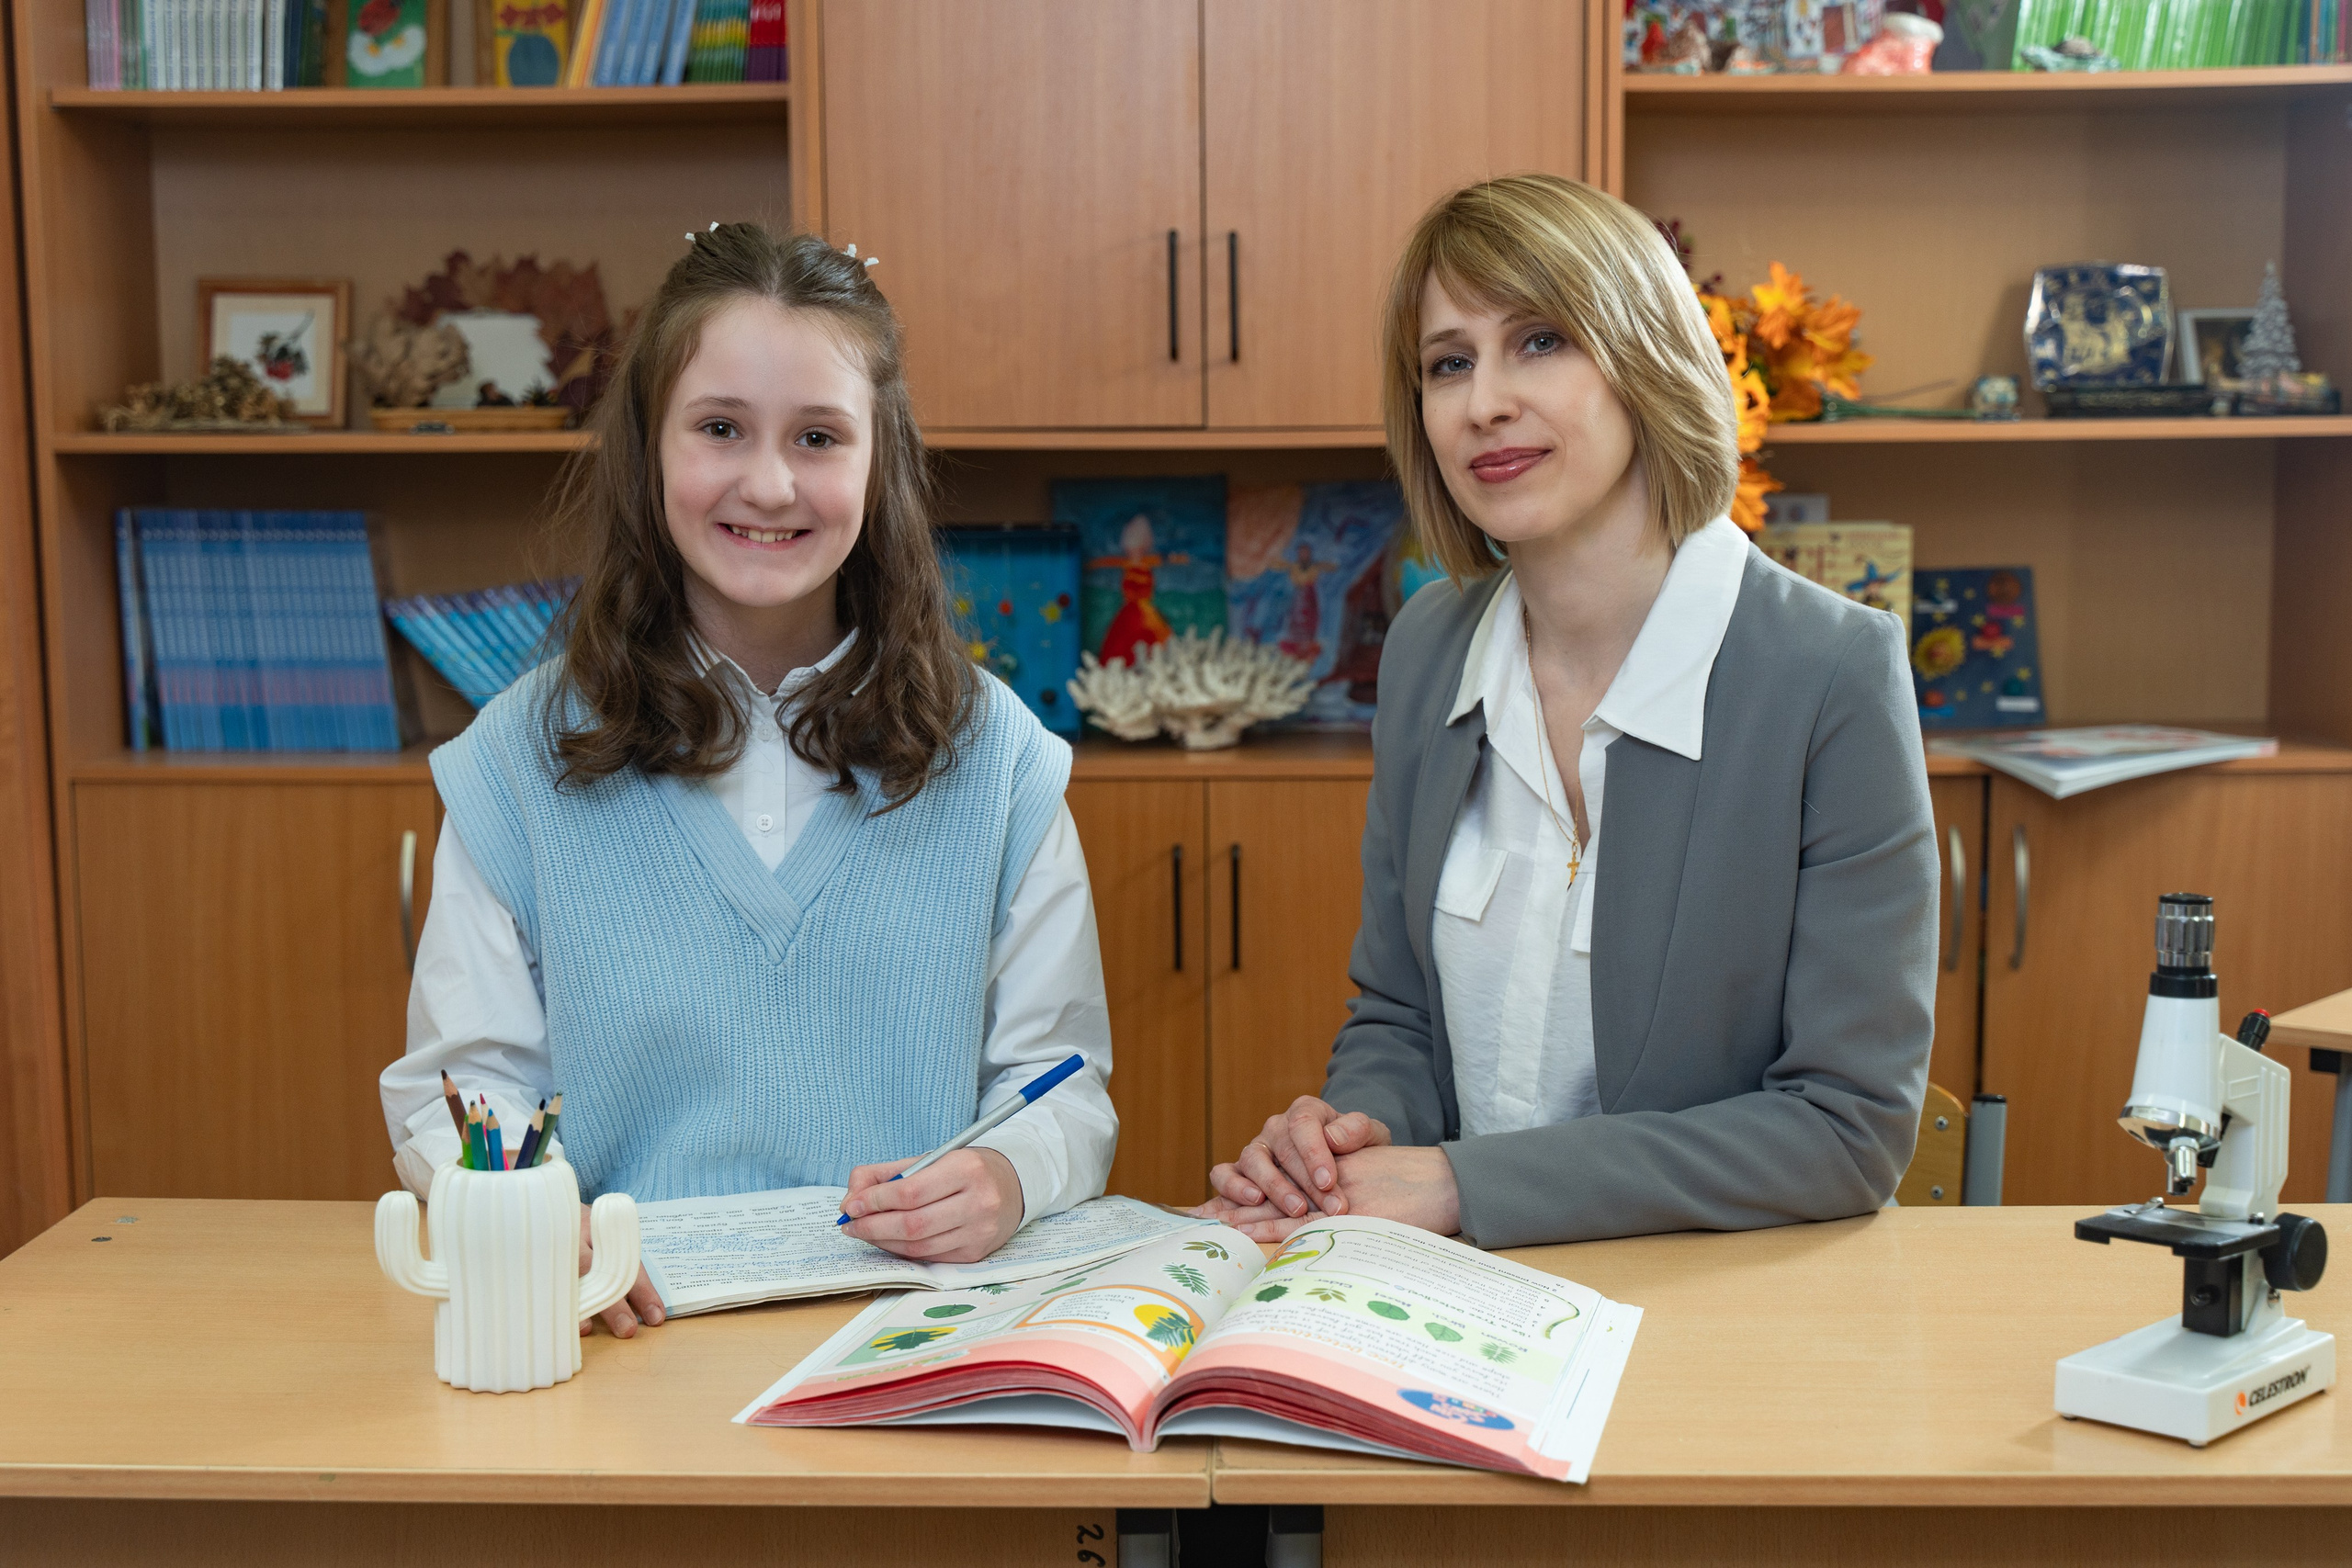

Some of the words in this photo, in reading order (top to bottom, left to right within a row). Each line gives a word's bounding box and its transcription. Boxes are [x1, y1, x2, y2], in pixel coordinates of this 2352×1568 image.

[1386, 1231, 1409, 1239] class.
[1383, 1241, 1406, 1250] Draw
[1352, 1247, 1367, 1256] the
[1385, 1249, 1401, 1258] tree
[1408, 1247, 1430, 1258] tree?
[1438, 1247, 1476, 1262] drawings
[1349, 1256, 1376, 1266] winter
[1381, 1255, 1408, 1268] colour
[1478, 1261, 1496, 1269] your
[1411, 1265, 1430, 1274] and
[1430, 1264, 1453, 1274] area
[1448, 1262, 1481, 1276] around
[1405, 1271, 1434, 1284] leaves
[1431, 1272, 1460, 1286] shape
[1453, 1272, 1469, 1280] top
[1482, 1275, 1505, 1285] there
[1498, 1269, 1529, 1281] present
[1314, 1279, 1352, 1289] Elder
[1531, 1280, 1549, 1289] Now
[1433, 1286, 1453, 1295] your
[1475, 1285, 1498, 1295] Draw
[1487, 1286, 1510, 1296] does
[1516, 1288, 1539, 1298] What
[1374, 1292, 1411, 1308] Hazel
[1407, 1289, 1465, 1313] Detective!
[1454, 1295, 1476, 1304] near
[1511, 1295, 1535, 1305] What
[1514, 1292, 1537, 1302] Draw
[1477, 1303, 1495, 1312] tree
[1508, 1303, 1531, 1313] What
[1467, 1313, 1497, 1325] Tree
[1504, 1310, 1527, 1319] Does
[1506, 1314, 1525, 1323] Find
[1344, 1321, 1363, 1330] got
[1355, 1319, 1381, 1329] some
[1431, 1313, 1466, 1330] Birch
[1498, 1317, 1522, 1327] What
[1385, 1329, 1402, 1337] are
[1260, 1326, 1363, 1353] Detectives!
[1331, 1334, 1362, 1346] types
[1358, 1334, 1380, 1343] type
[1406, 1337, 1429, 1349] Here
[1481, 1331, 1528, 1353] Rowan
[1367, 1344, 1416, 1364] different
[1386, 1343, 1409, 1355] what
[1414, 1345, 1437, 1359] each
[1367, 1351, 1405, 1369] Tree
[1414, 1355, 1434, 1365] tell
[1460, 1358, 1477, 1369] and
[1421, 1363, 1446, 1377] many
[1441, 1363, 1458, 1372] you
[1454, 1362, 1488, 1381] leaves
[1462, 1372, 1479, 1382] can
[1482, 1368, 1510, 1380] shape
[1473, 1385, 1500, 1398] There
[1485, 1382, 1504, 1393] How
[2248, 1369, 2308, 1407] CELESTRON
[1076, 1523, 1106, 1568] 26
